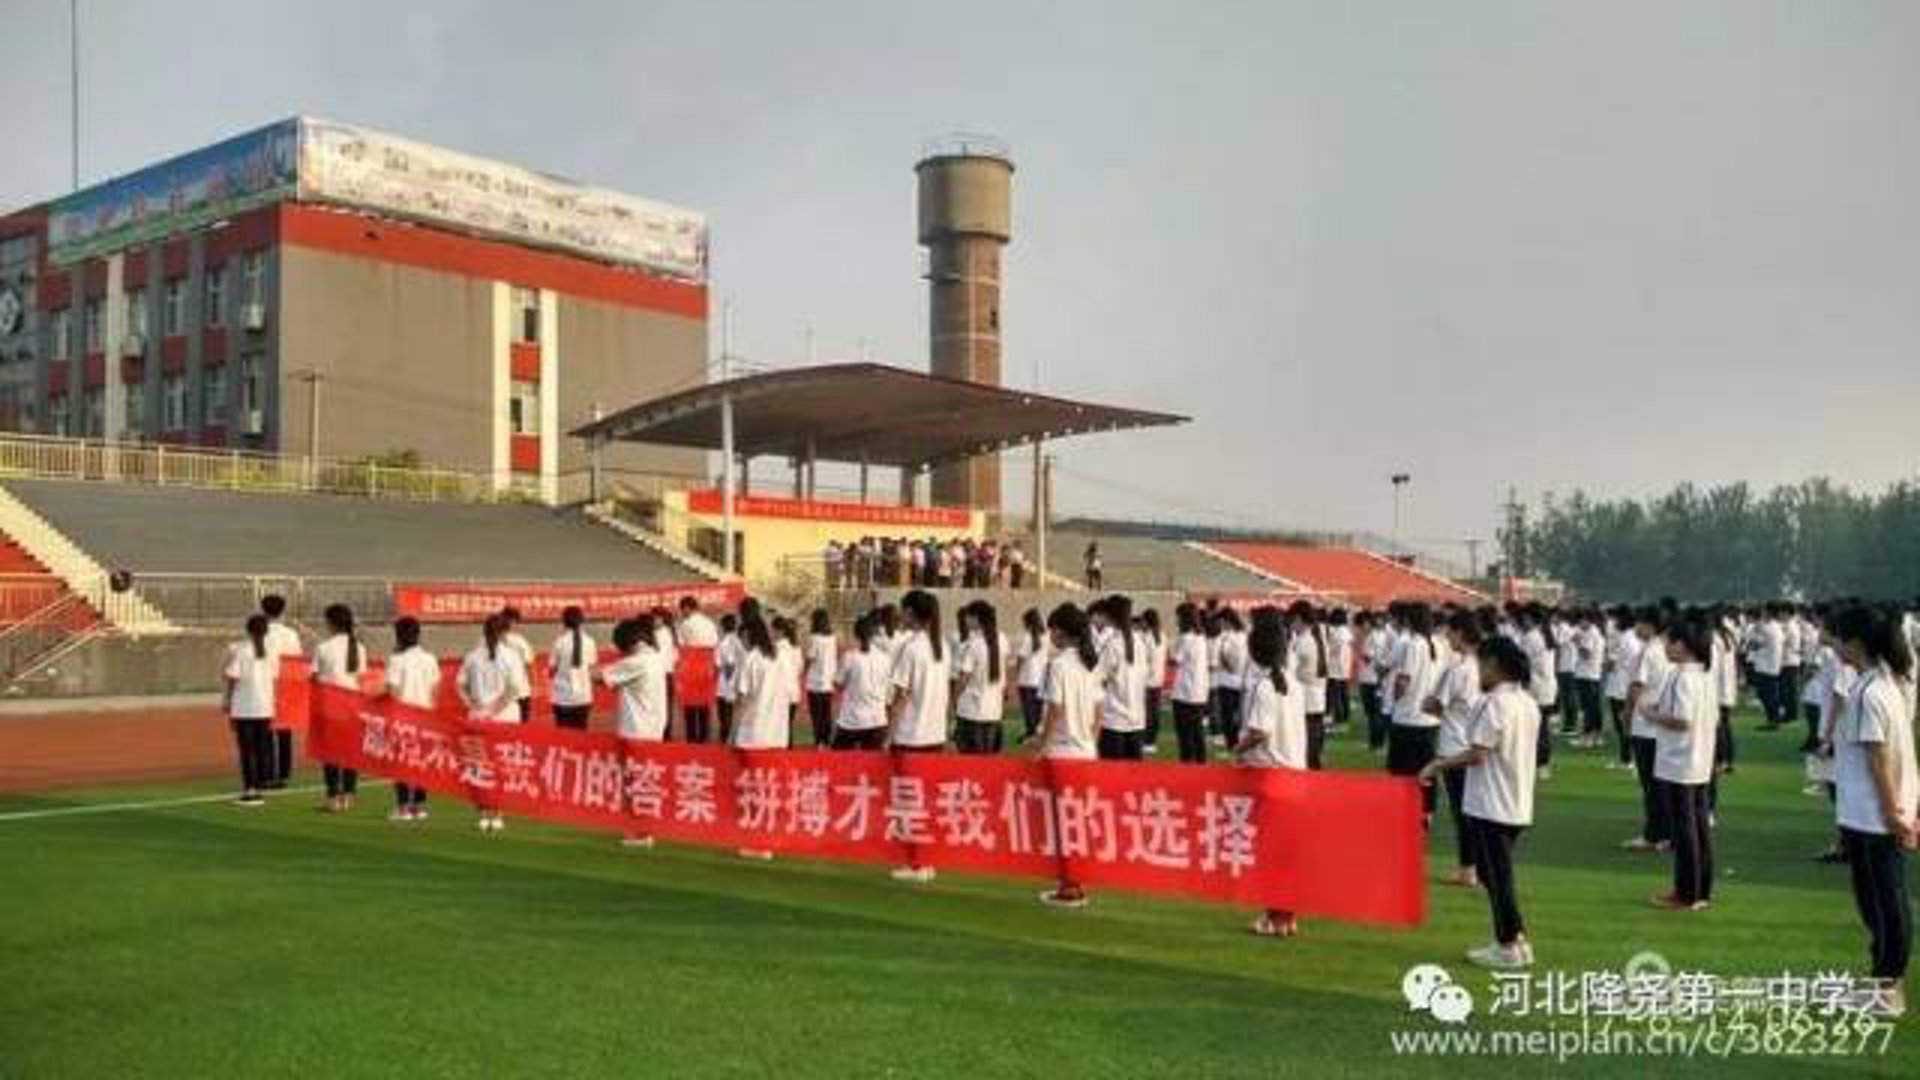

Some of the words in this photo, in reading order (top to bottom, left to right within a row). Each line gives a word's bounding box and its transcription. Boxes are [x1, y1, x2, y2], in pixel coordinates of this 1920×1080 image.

[734, 767, 1258, 877] 拼搏才是我们的选择
